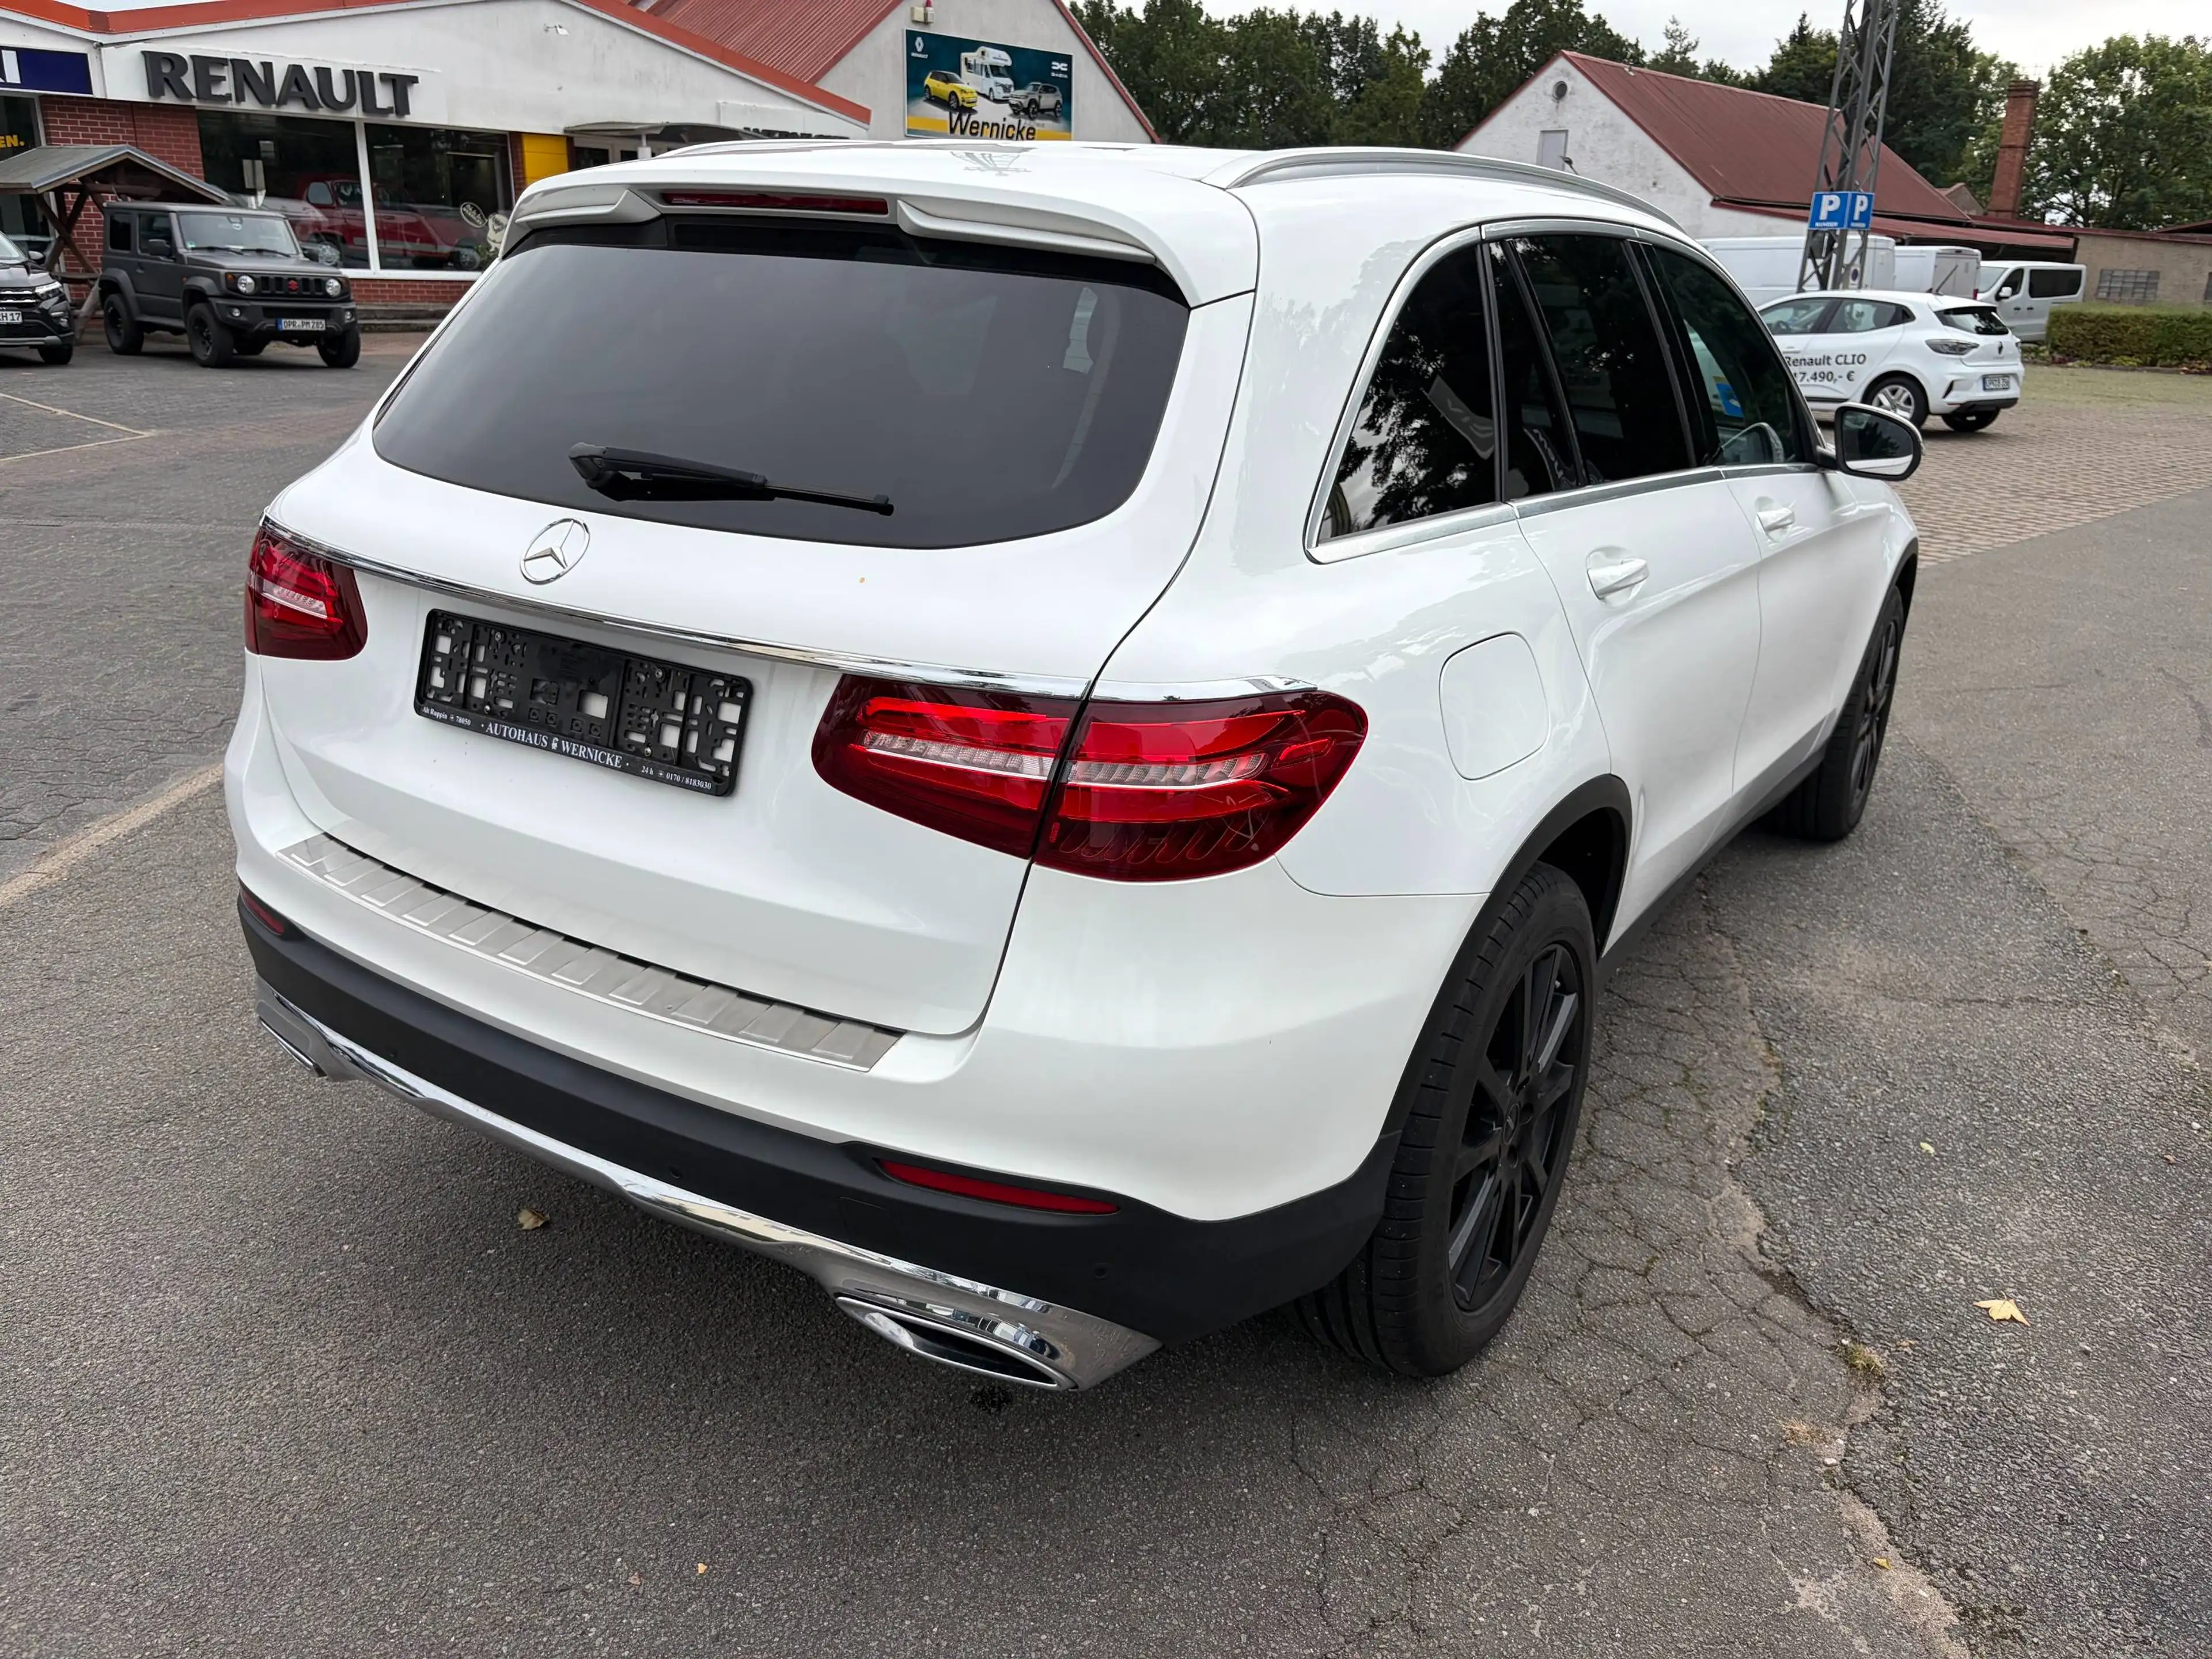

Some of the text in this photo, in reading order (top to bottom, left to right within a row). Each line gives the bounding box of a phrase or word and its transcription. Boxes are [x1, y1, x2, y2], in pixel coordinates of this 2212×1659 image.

[141, 50, 419, 117] RENAULT
[949, 111, 1036, 141] Wernicke
[1819, 195, 1840, 221] P
[1853, 195, 1868, 221] P
[0, 313, 21, 321] H 17
[1785, 354, 1866, 367] Renault CLIO
[430, 708, 448, 720] Ruppin
[486, 722, 548, 748] AUTOHAUS
[562, 740, 623, 768] WERNICKE
[641, 766, 649, 774] 24
